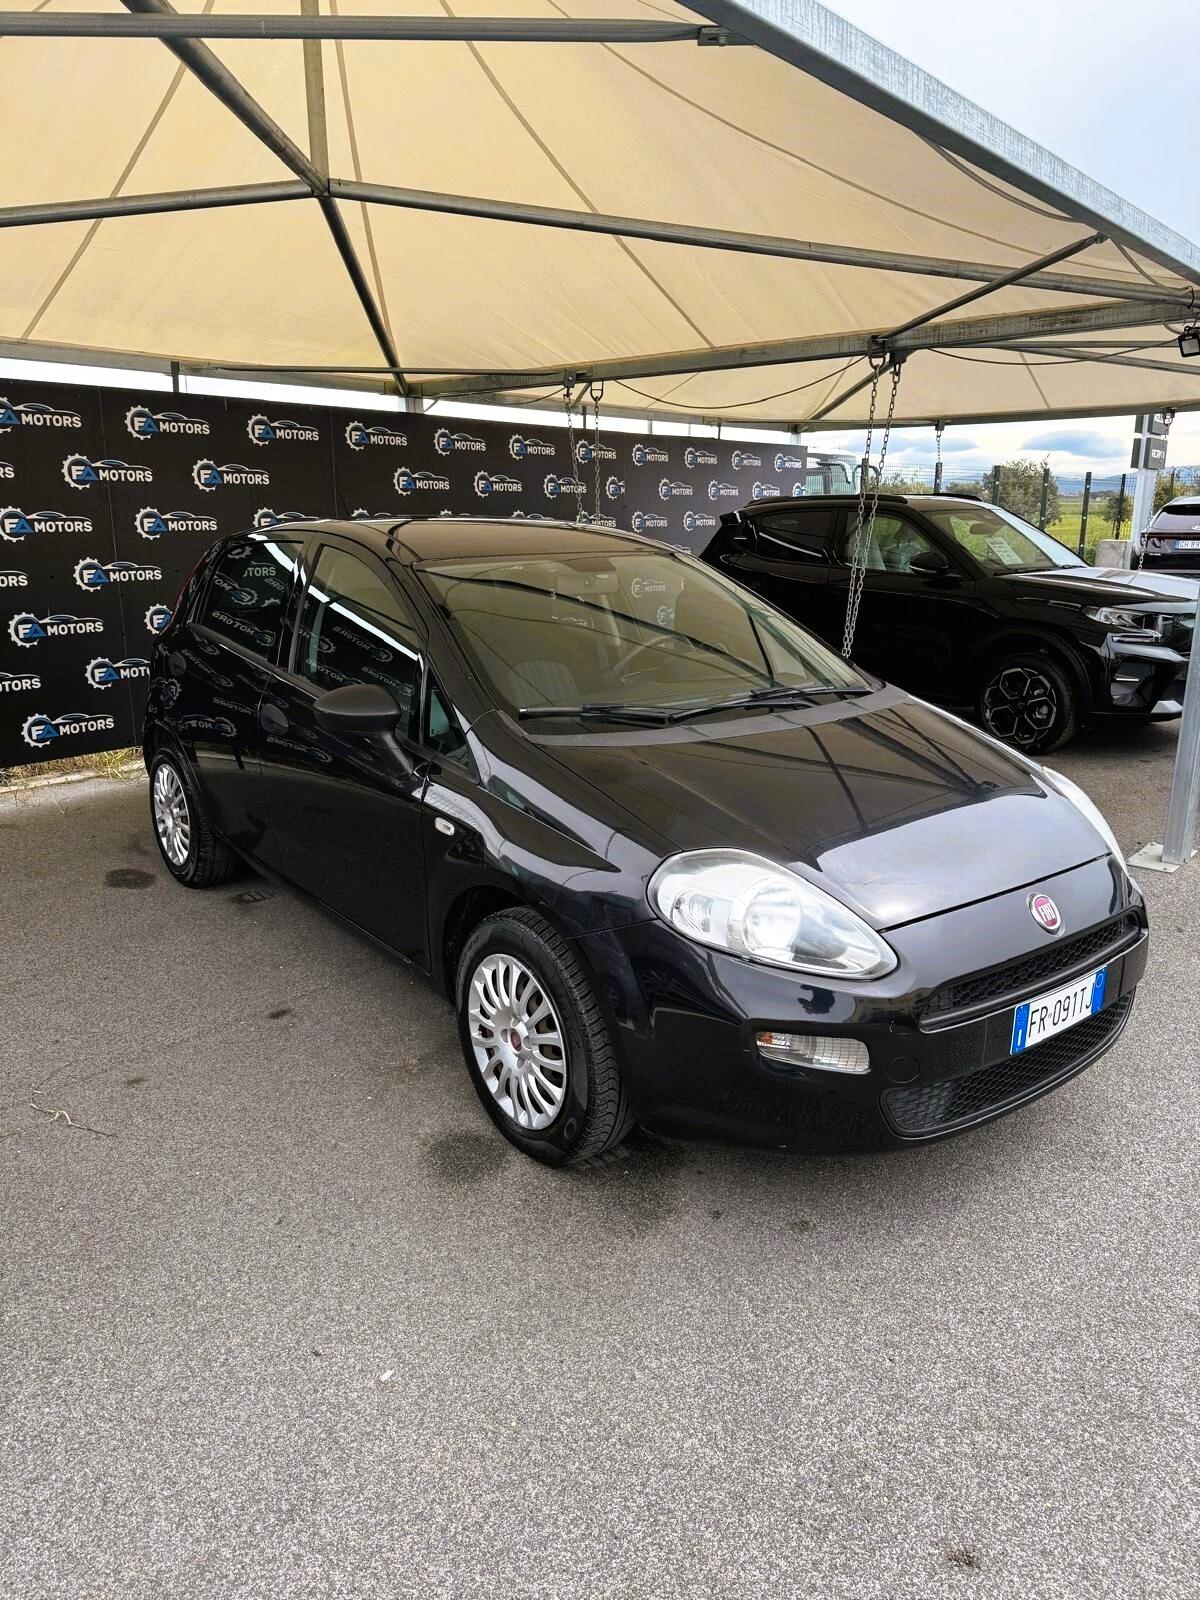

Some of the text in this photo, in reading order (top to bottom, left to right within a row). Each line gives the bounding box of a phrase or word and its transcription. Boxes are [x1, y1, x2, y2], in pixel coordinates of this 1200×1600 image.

[21, 413, 82, 428] MOTORS
[160, 421, 210, 435] MOTORS
[276, 429, 319, 441] MOTORS
[370, 435, 408, 447] MOTORS
[455, 441, 486, 452] MOTORS
[527, 446, 556, 456] MOTORS
[592, 449, 617, 460] MOTORS
[646, 454, 669, 462] MOTORS
[698, 456, 718, 465] MOTORS
[743, 458, 761, 467] MOTORS
[99, 469, 153, 482] MOTORS
[223, 473, 270, 485] MOTORS
[416, 479, 450, 490] MOTORS
[493, 482, 523, 493] MOTORS
[560, 484, 587, 494] MOTORS
[672, 487, 693, 496] MOTORS
[720, 487, 739, 496] MOTORS
[763, 488, 780, 496] MOTORS
[34, 521, 93, 533] MOTORS
[168, 520, 218, 531] MOTORS
[646, 519, 667, 527] MOTORS
[109, 570, 162, 582] MOTORS
[47, 621, 104, 636] MOTORS
[59, 718, 115, 736] MOTORS
